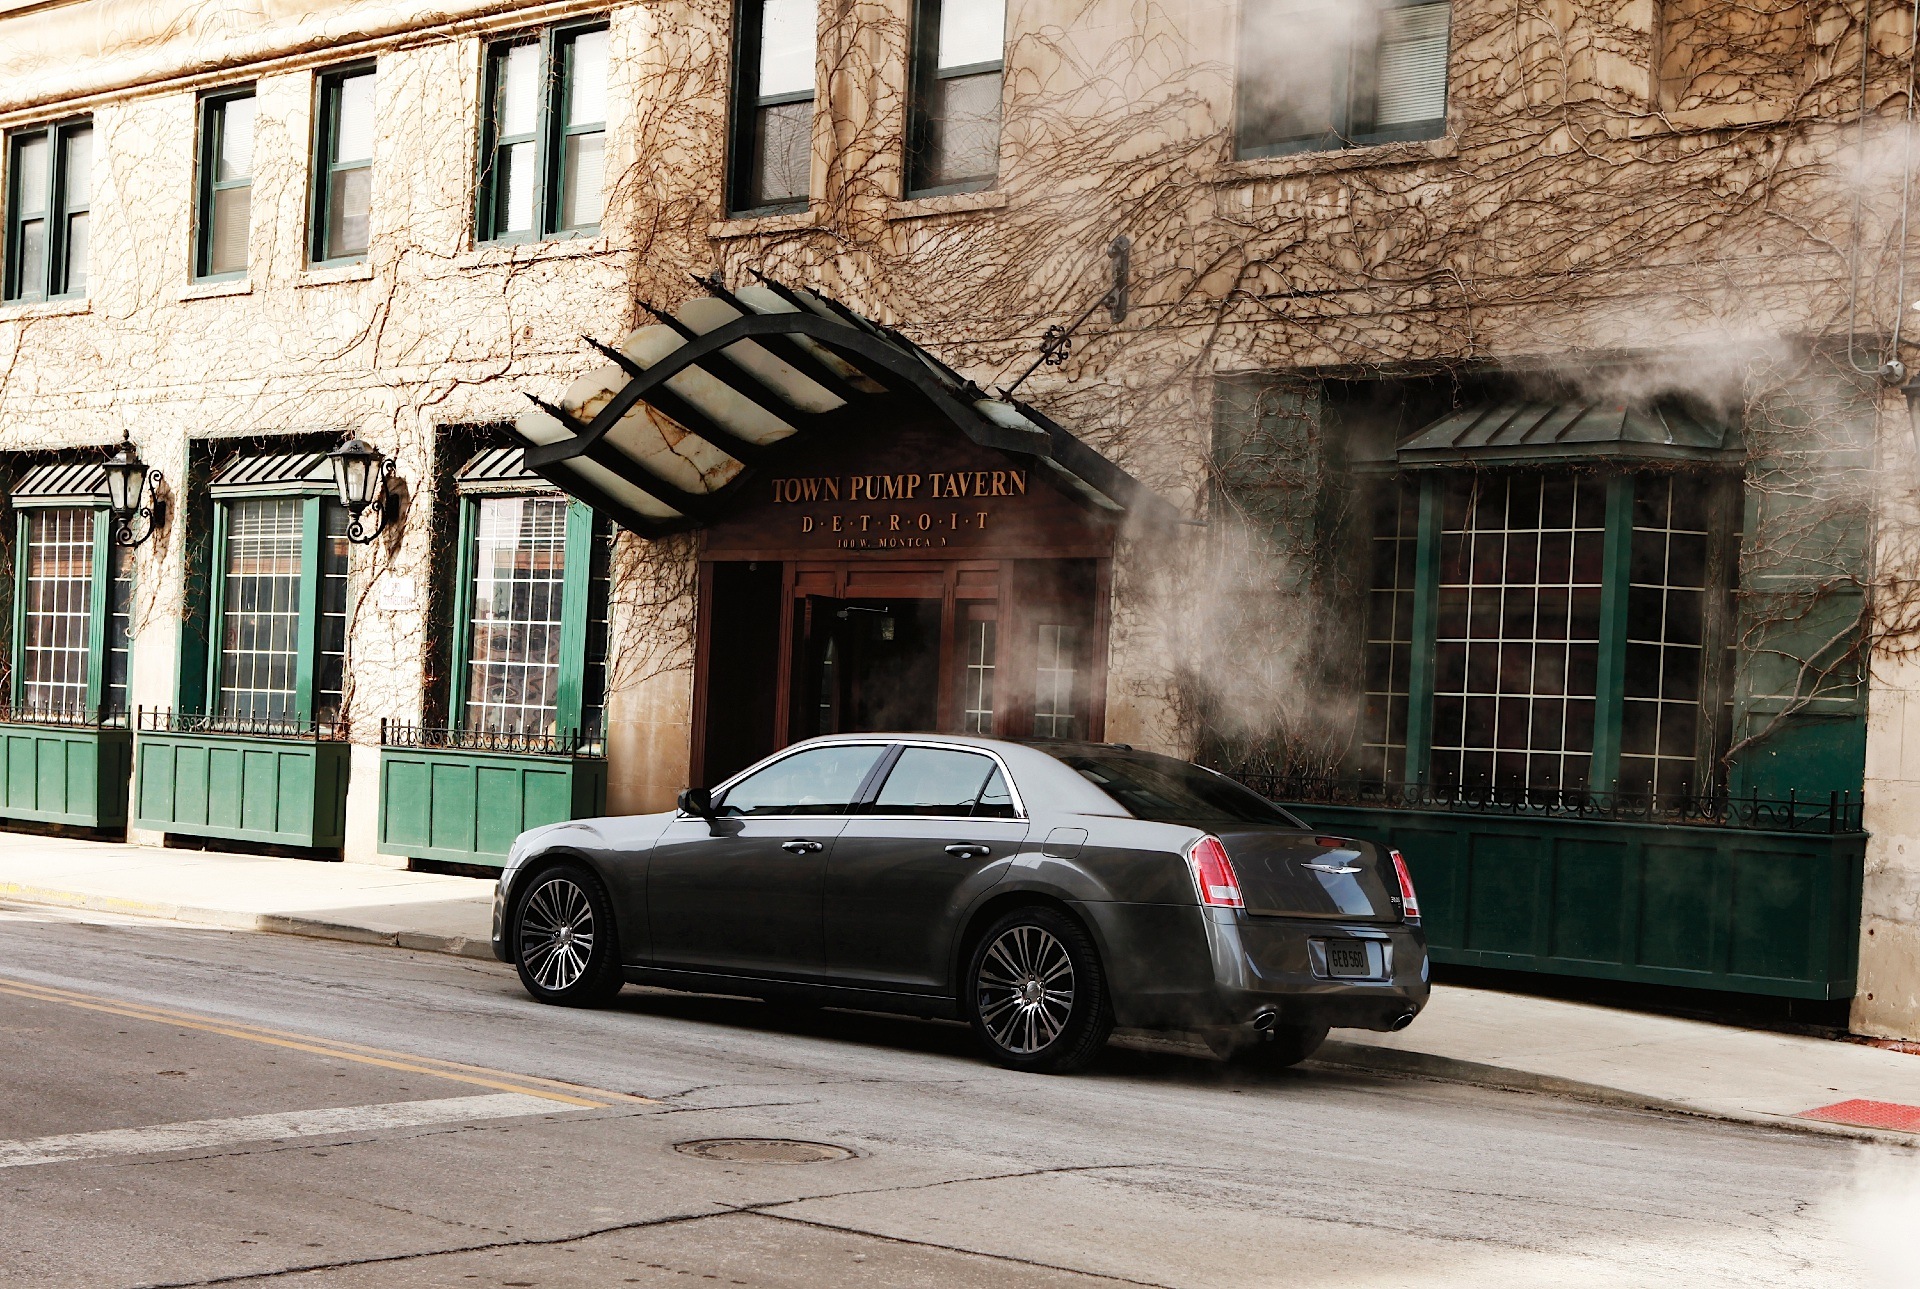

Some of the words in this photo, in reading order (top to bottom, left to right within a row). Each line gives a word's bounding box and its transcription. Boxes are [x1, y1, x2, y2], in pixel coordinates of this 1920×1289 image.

[771, 477, 840, 503] TOWN
[849, 473, 921, 501] PUMP
[928, 470, 1026, 498] TAVERN
[837, 538, 855, 548] 100
[860, 538, 870, 548] W.
